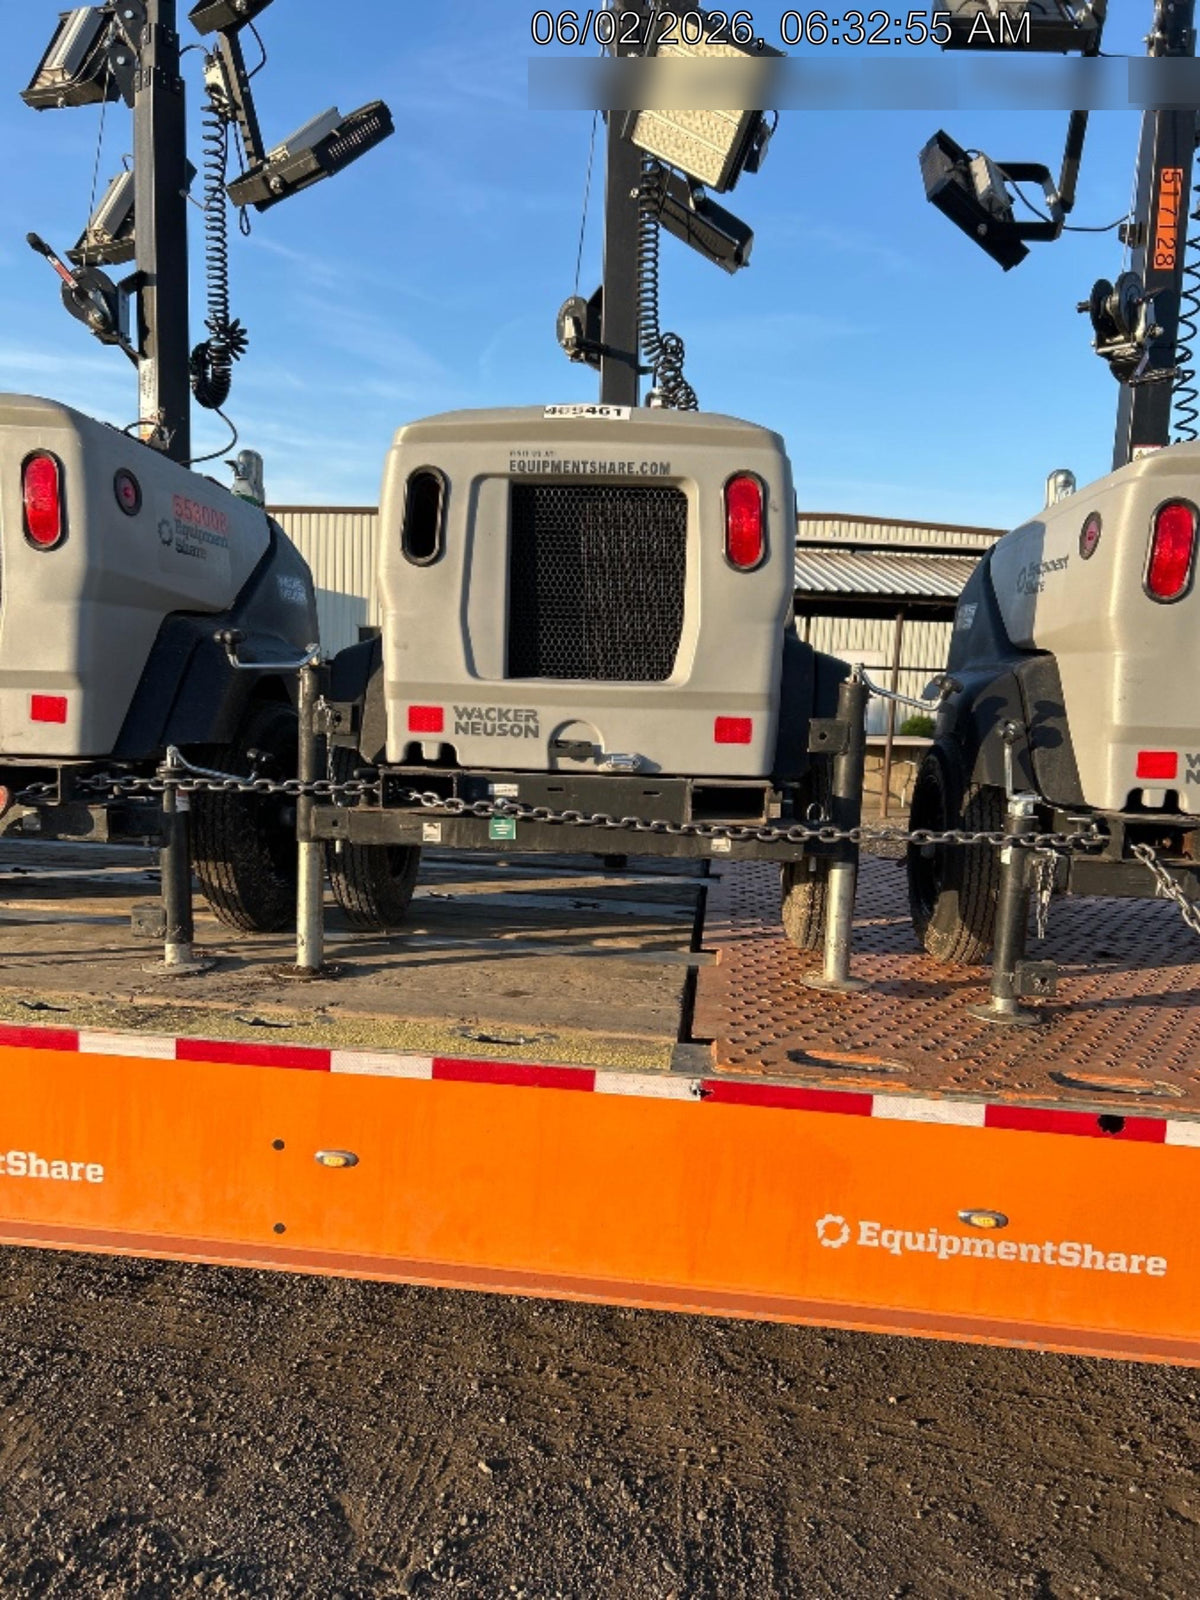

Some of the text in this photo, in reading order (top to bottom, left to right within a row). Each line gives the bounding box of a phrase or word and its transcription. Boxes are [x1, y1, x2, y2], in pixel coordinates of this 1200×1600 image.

[509, 459, 671, 475] EQUIPMENTSHARE.COM
[453, 705, 540, 724] WACKER
[454, 721, 540, 739] NEUSON
[856, 1219, 1168, 1278] EquipmentShare
